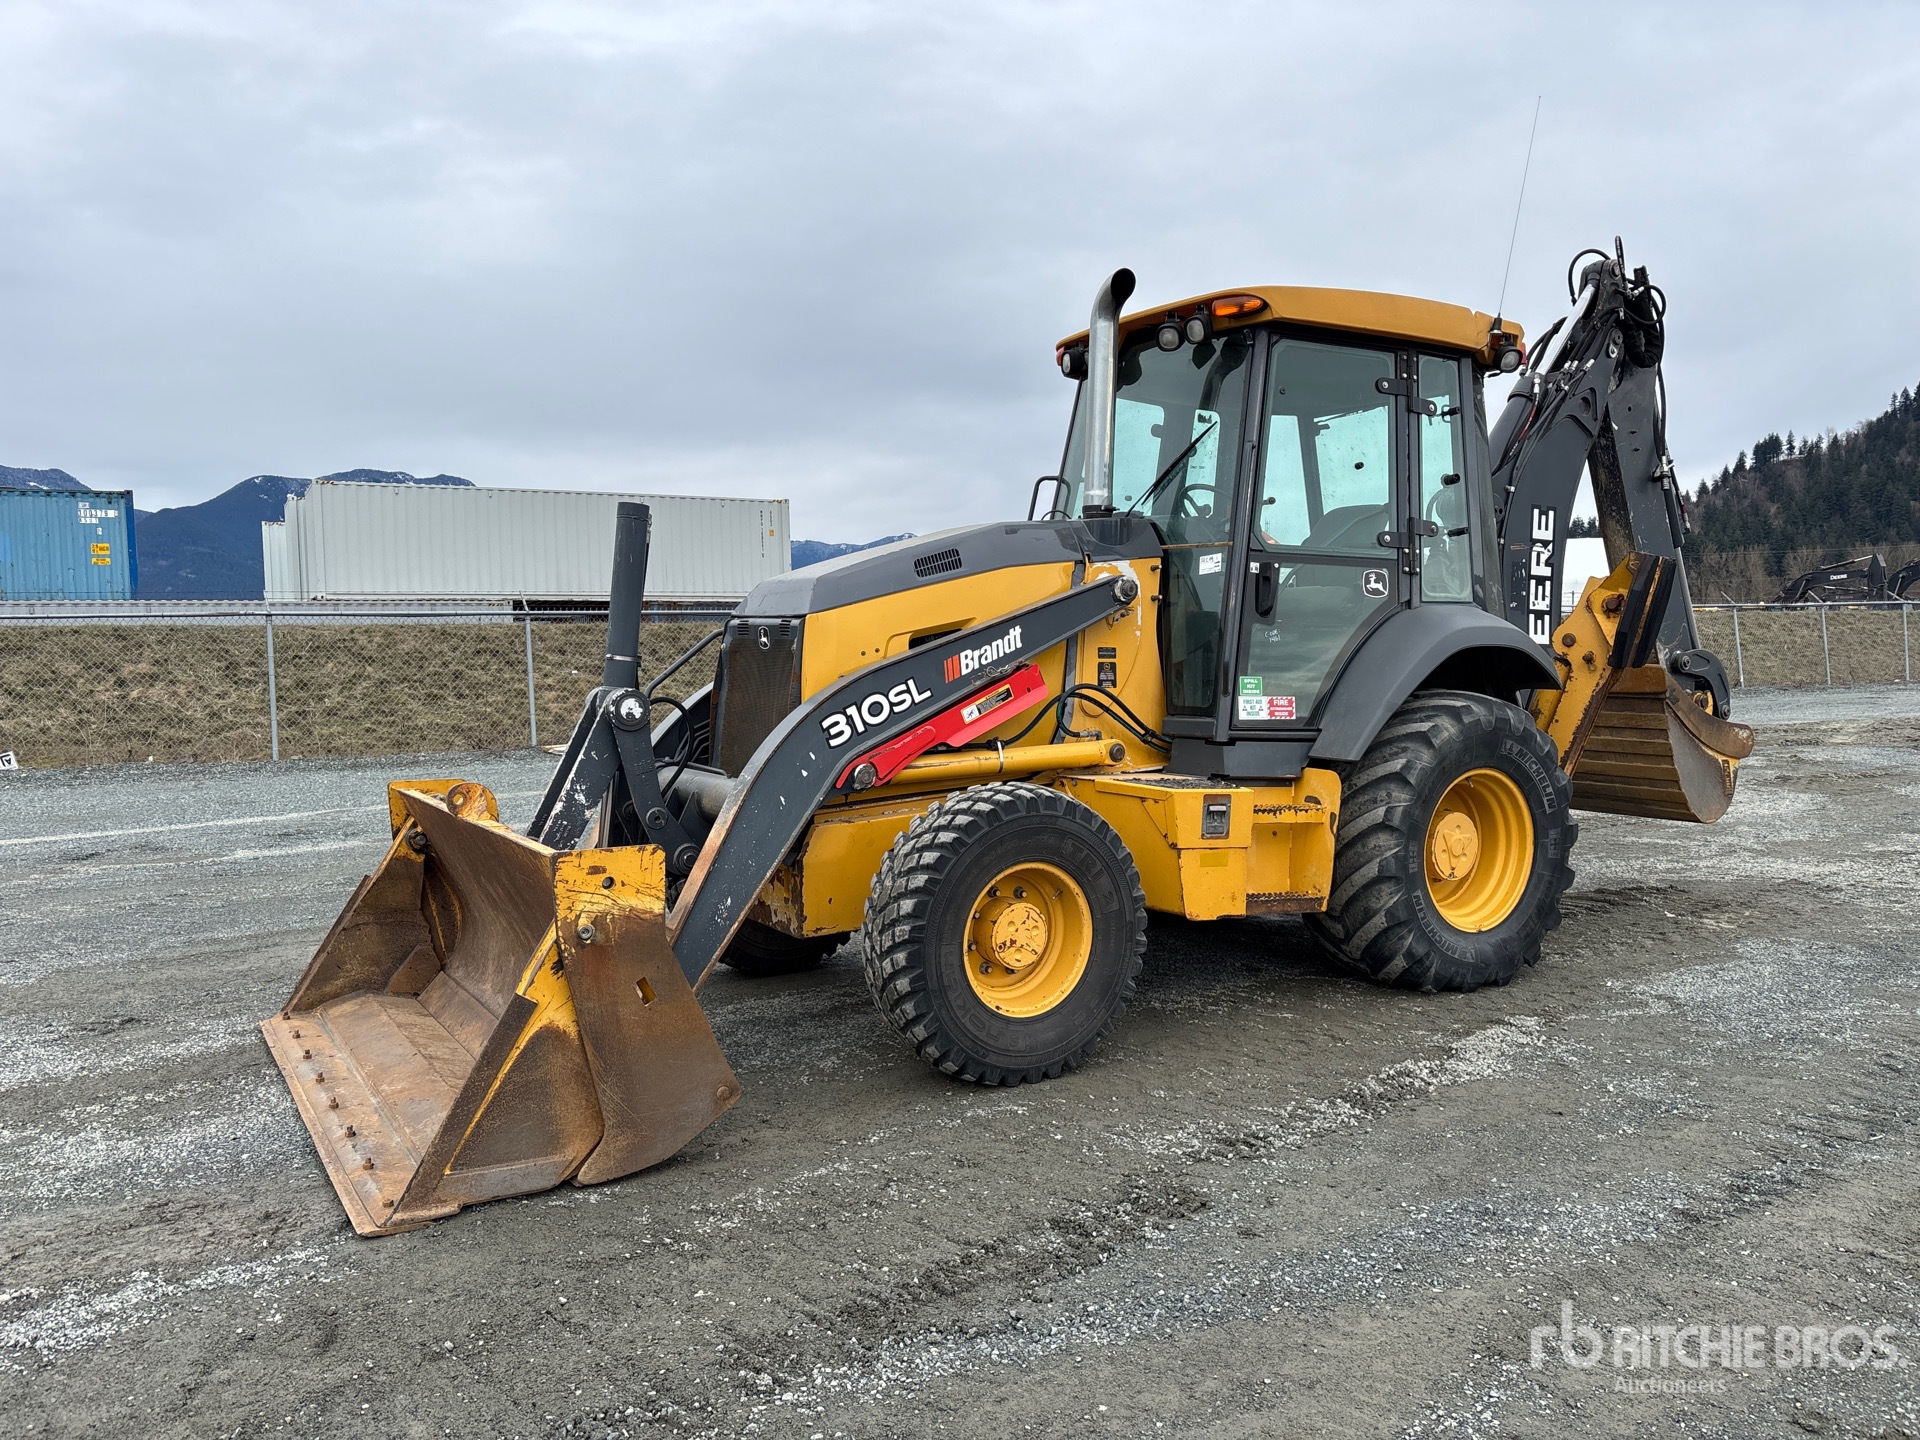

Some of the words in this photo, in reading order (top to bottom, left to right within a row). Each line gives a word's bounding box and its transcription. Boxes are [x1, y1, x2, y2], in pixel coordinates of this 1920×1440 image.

[1529, 508, 1554, 644] EERE
[961, 625, 1022, 676] Brandt
[820, 678, 932, 748] 310SL
[1515, 748, 1557, 809] MICHELIN
[1071, 843, 1105, 882] TRI
[1102, 891, 1115, 905] 2
[1413, 895, 1459, 957] MICHELIN
